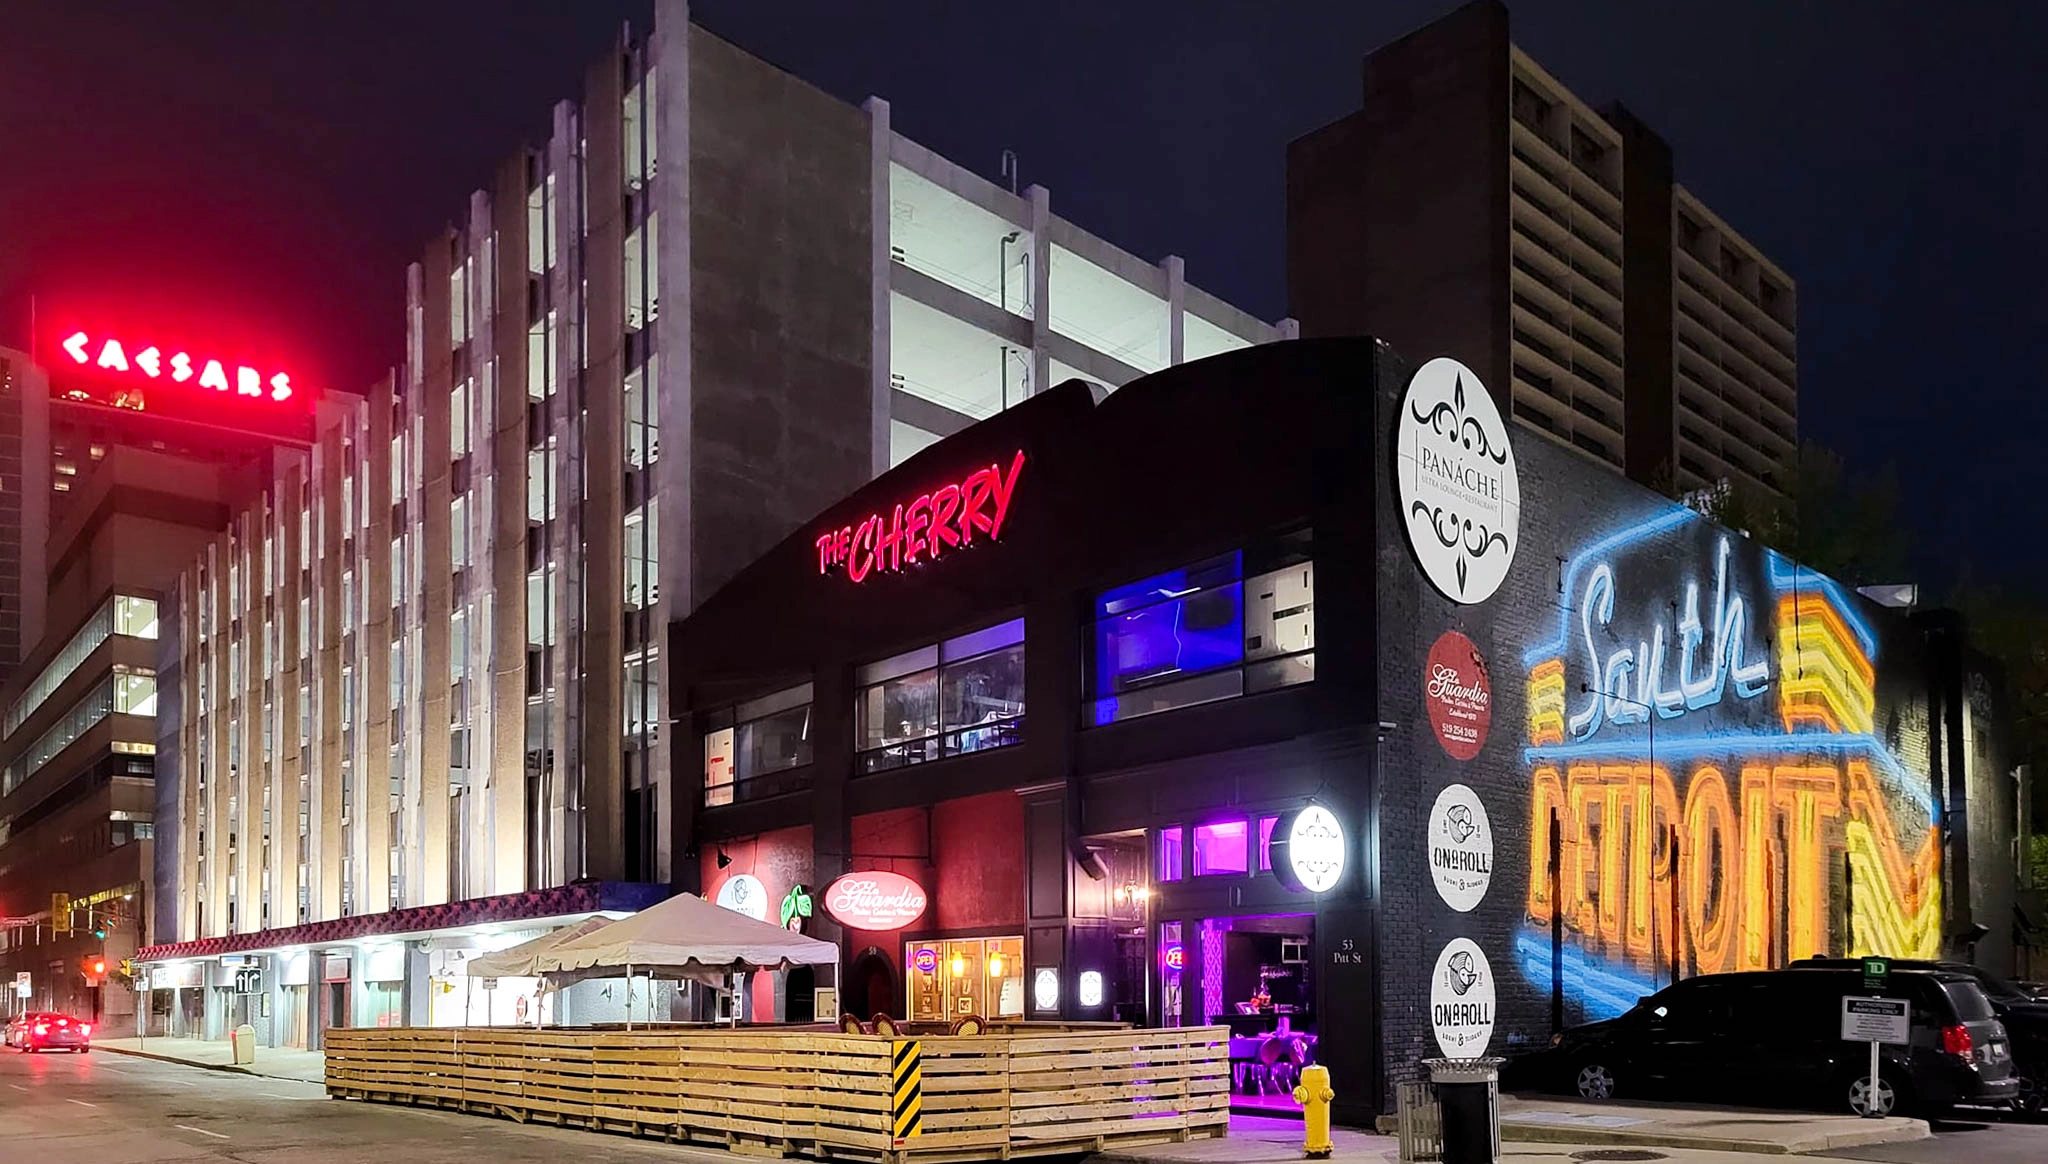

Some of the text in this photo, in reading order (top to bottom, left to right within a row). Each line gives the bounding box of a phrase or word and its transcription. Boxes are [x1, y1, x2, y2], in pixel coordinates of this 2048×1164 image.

[63, 331, 293, 401] CAESARS
[1422, 447, 1499, 501] PANÁCHE
[816, 449, 1025, 582] THE CHERRY
[1569, 536, 1770, 743] South
[1428, 663, 1489, 705] Guardia
[1528, 763, 1842, 976] DETROIT
[832, 879, 924, 912] Guardia
[1333, 951, 1361, 964] Pitt St
[1342, 939, 1354, 951] 53
[1867, 962, 1885, 974] TD
